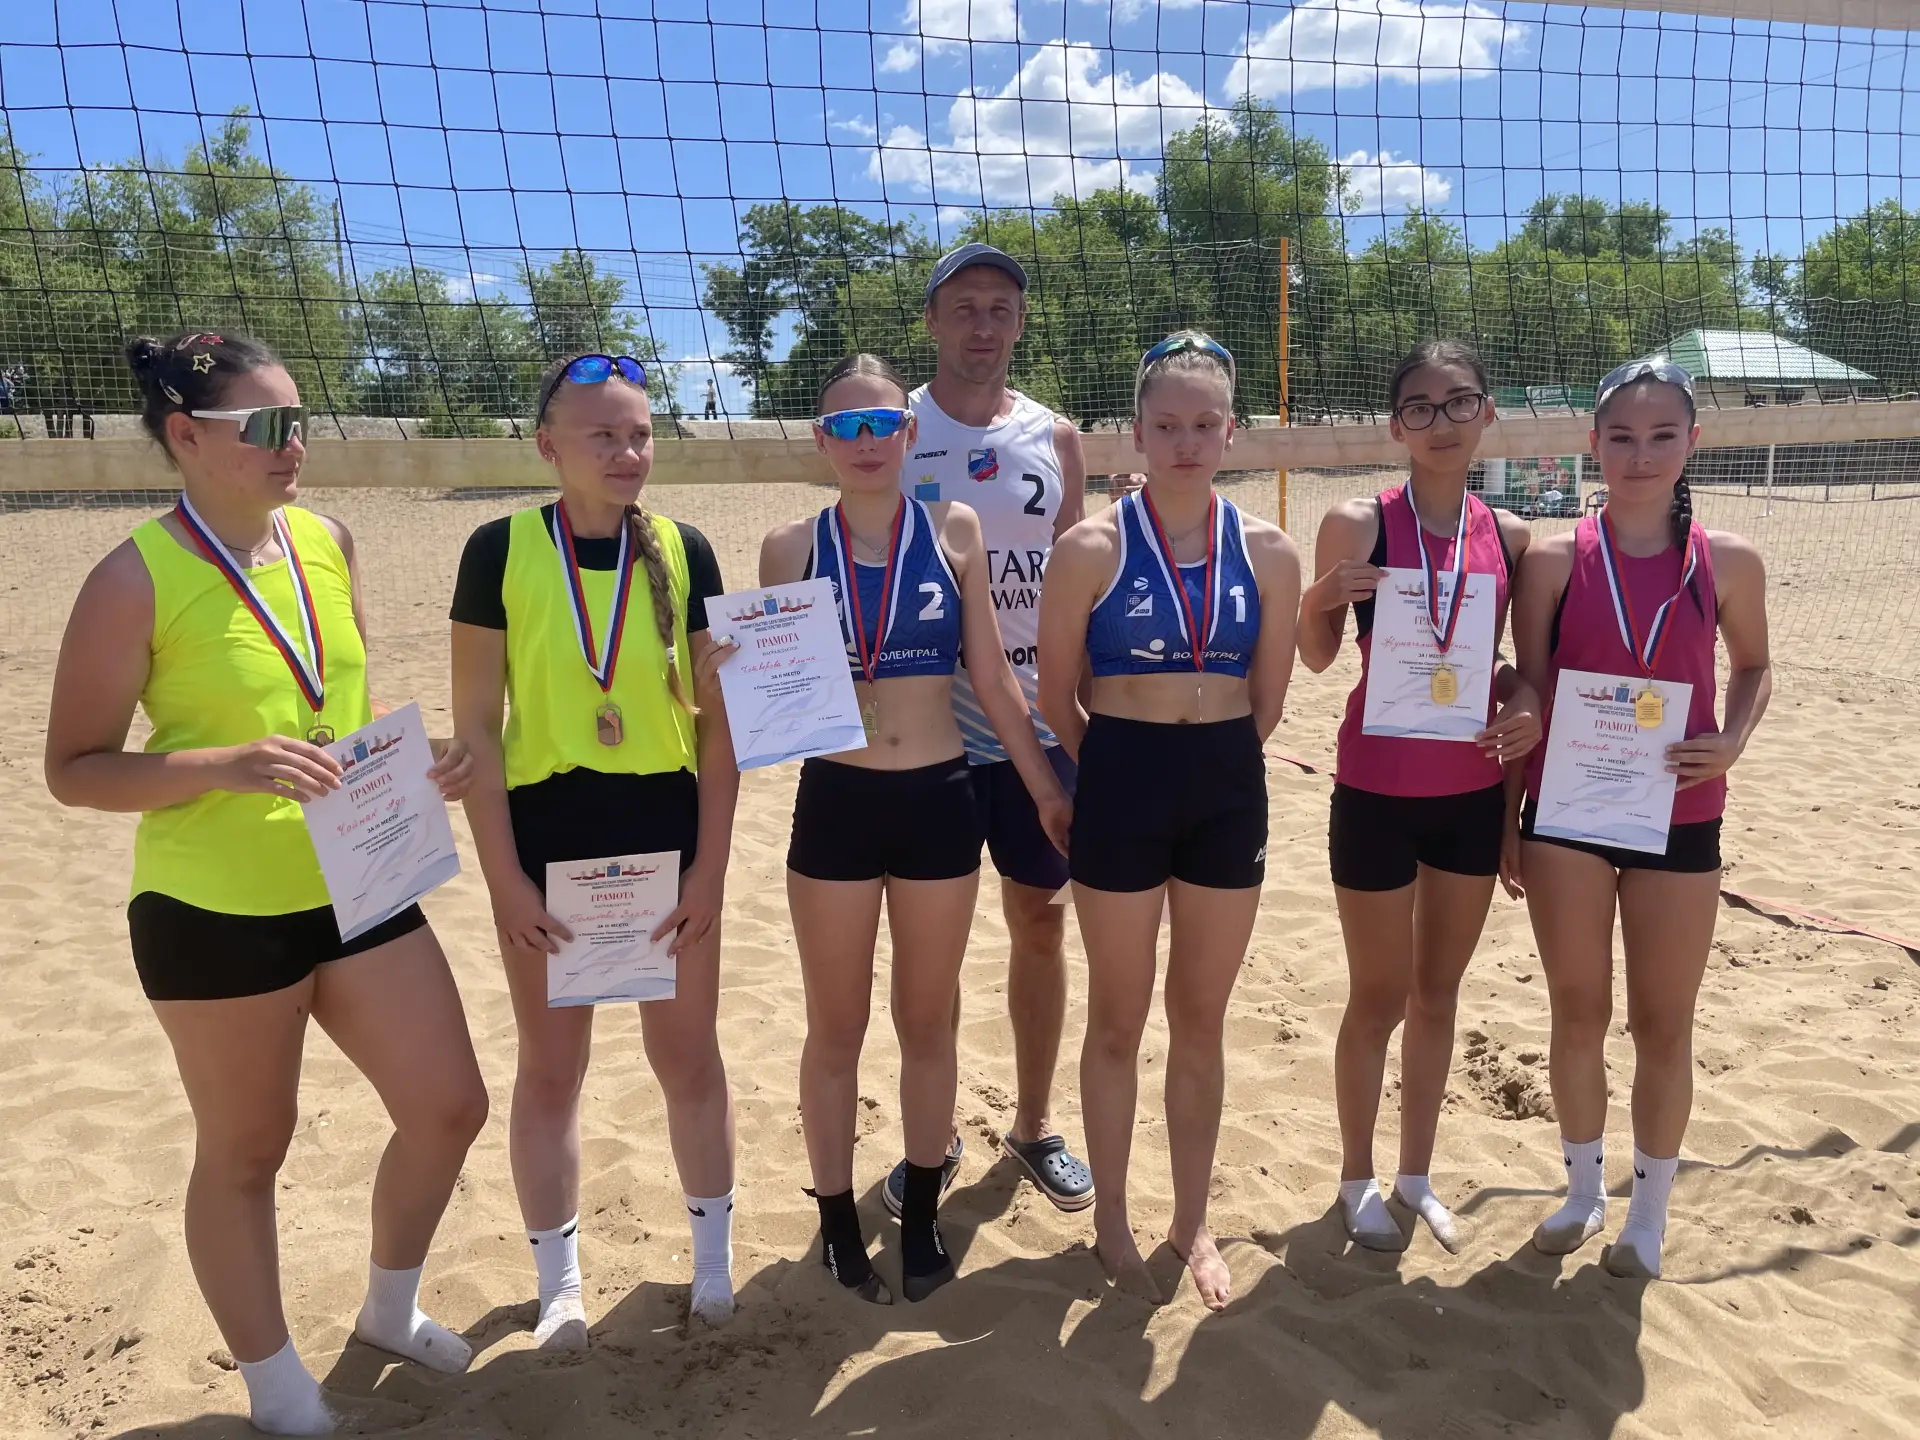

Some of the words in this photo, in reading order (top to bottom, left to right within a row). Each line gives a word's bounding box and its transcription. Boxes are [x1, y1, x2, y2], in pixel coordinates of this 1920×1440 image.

[914, 450, 948, 460] ENSEN
[1022, 473, 1046, 516] 2
[987, 550, 1043, 583] TAR
[918, 582, 945, 621] 2
[990, 589, 1041, 610] WAY
[1229, 585, 1246, 622] 1
[756, 632, 799, 648] ГРАМОТА
[1594, 719, 1637, 733] ГРАМОТА
[349, 773, 392, 801] ГРАМОТА
[380, 813, 398, 824] МЕСТО
[591, 891, 633, 901] ГРАМОТА
